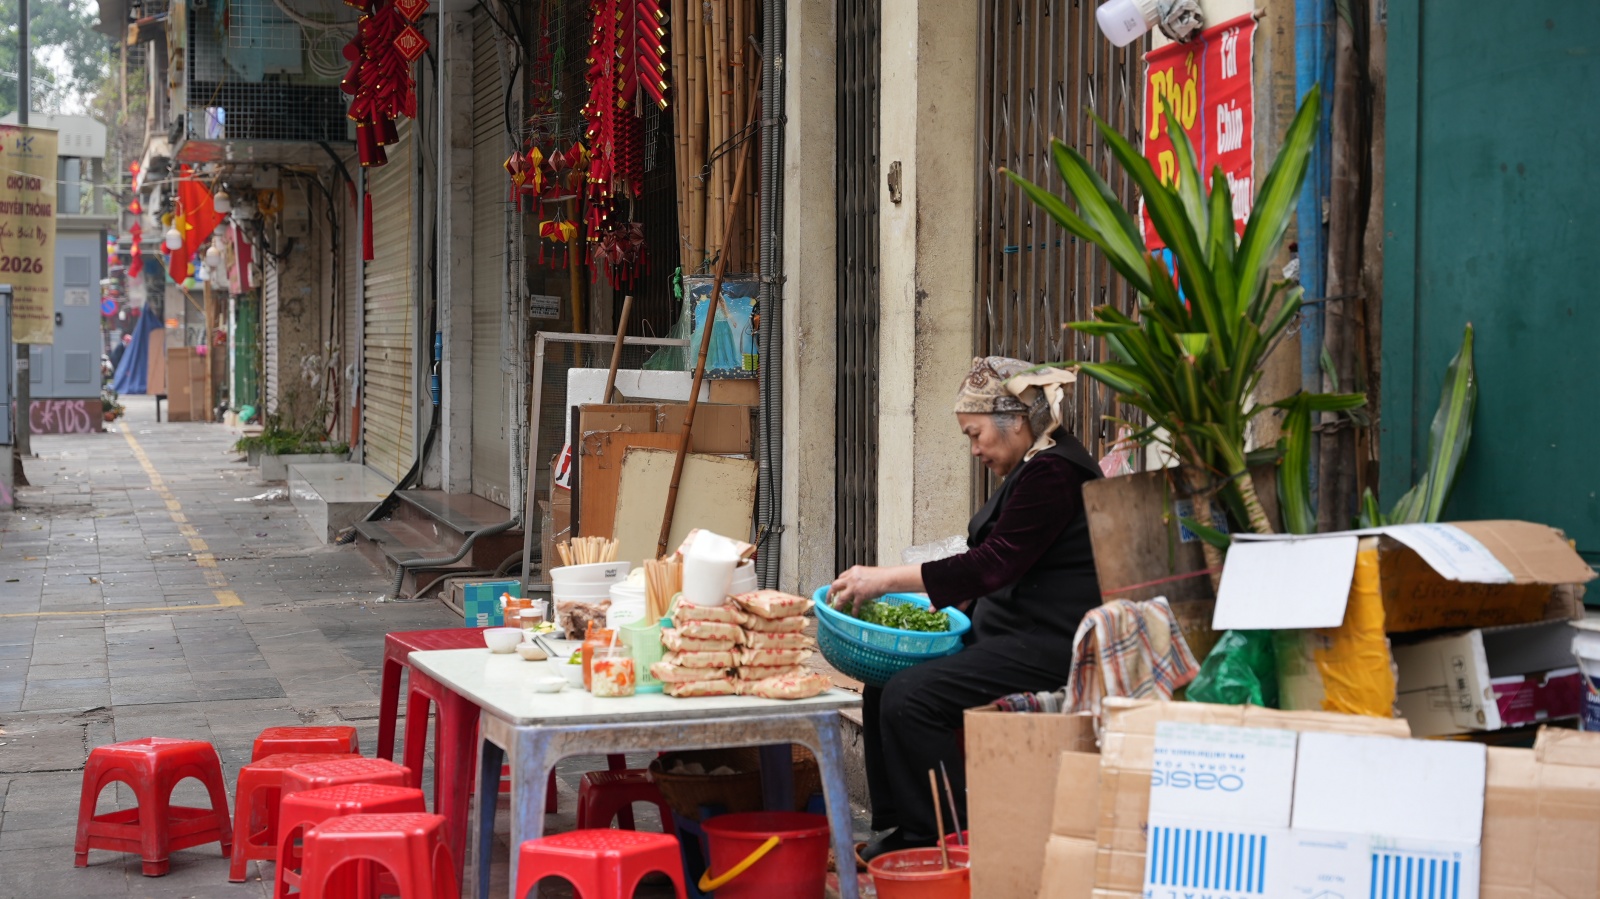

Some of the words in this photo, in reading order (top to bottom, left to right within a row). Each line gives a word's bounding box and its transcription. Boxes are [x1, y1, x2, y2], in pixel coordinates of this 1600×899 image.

[1149, 50, 1197, 140] Phở
[1217, 98, 1243, 155] Chín
[25, 178, 41, 191] HOA
[25, 197, 51, 217] THỐNG
[0, 256, 43, 273] 2026
